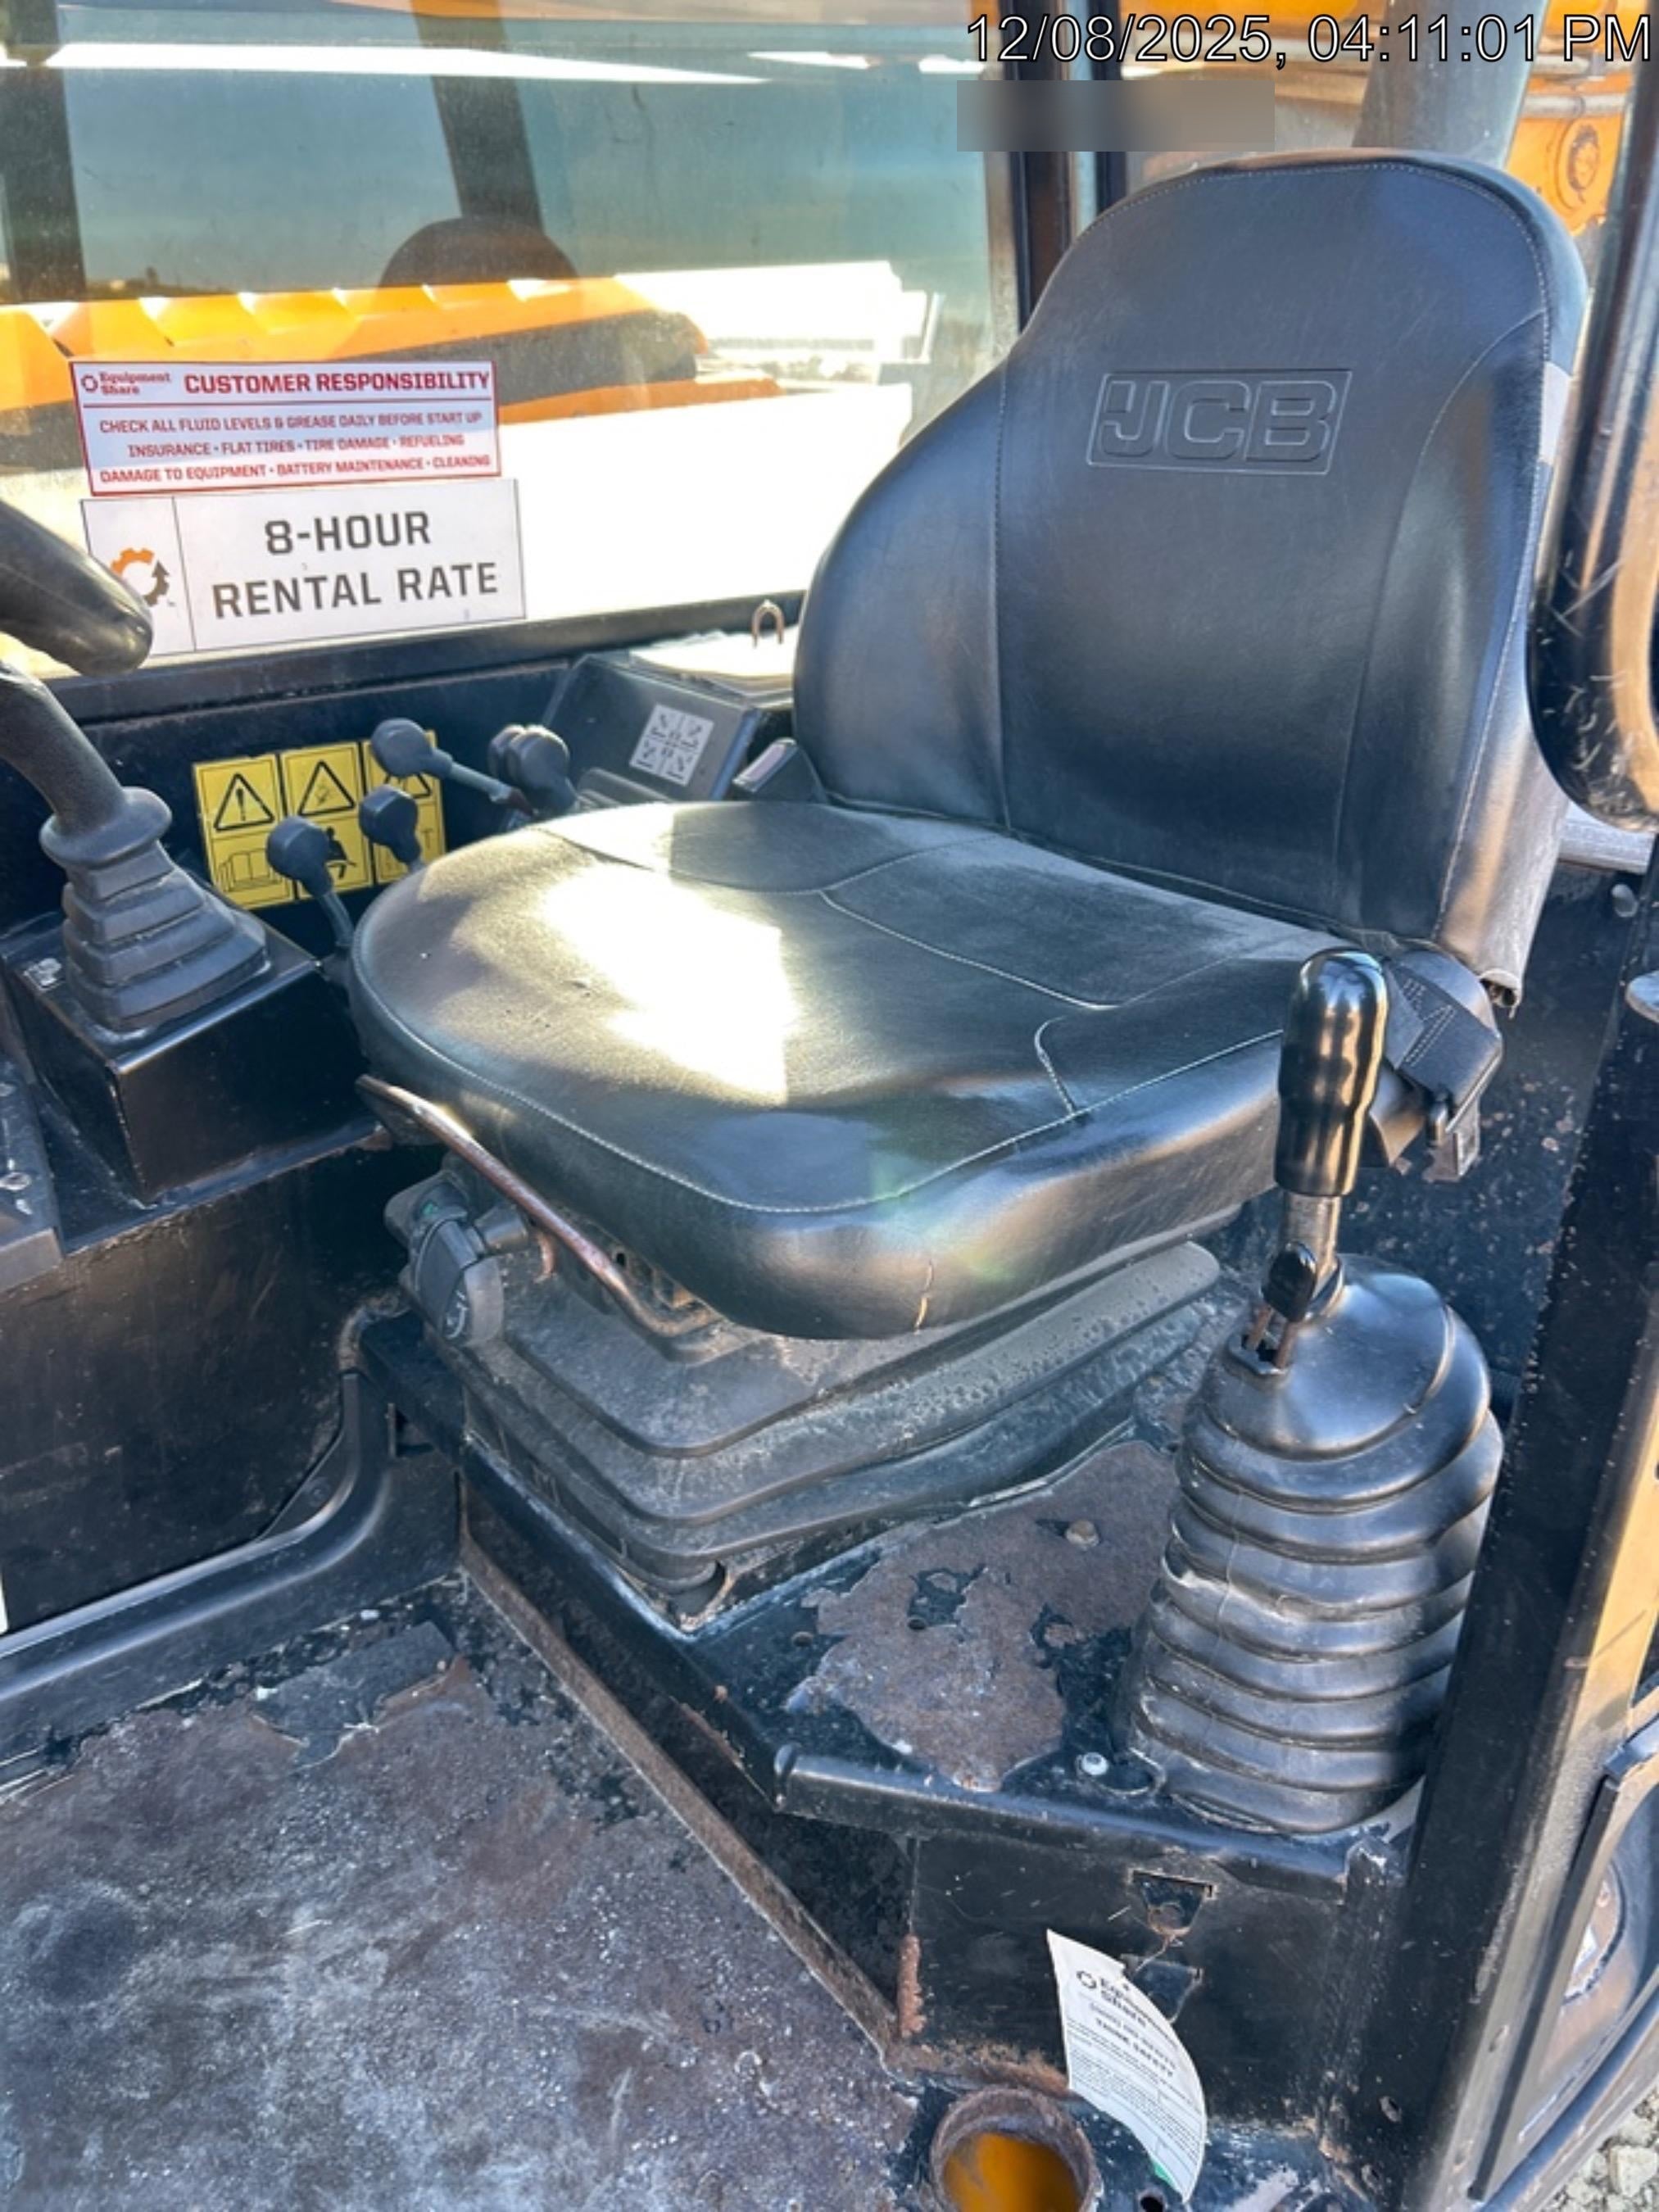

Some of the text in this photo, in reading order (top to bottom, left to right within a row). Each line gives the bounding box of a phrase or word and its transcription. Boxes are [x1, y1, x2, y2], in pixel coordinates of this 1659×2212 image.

[99, 372, 170, 383] Equipment
[101, 383, 139, 395] Share
[184, 371, 490, 394] CUSTOMER RESPONSIBILITY
[100, 419, 148, 433] CHECK
[152, 419, 176, 432] ALL
[179, 417, 221, 431] FLUID
[224, 416, 271, 430] LEVELS
[287, 415, 336, 428] GREASE
[339, 413, 374, 426] DAILY
[378, 412, 424, 425] BEFORE
[427, 411, 462, 424] START
[465, 411, 482, 423] UP
[1099, 380, 1338, 463] JCB
[128, 434, 465, 457] INSURANCE FLAT TIRES TIRE DAMAGE REFUELING
[100, 454, 490, 483] DAMAGE TO EQUIPMENT BATTERY MAINTENANCE CLEANING
[265, 511, 431, 555] 8-HOUR
[211, 562, 498, 619] RENTAL RATE
